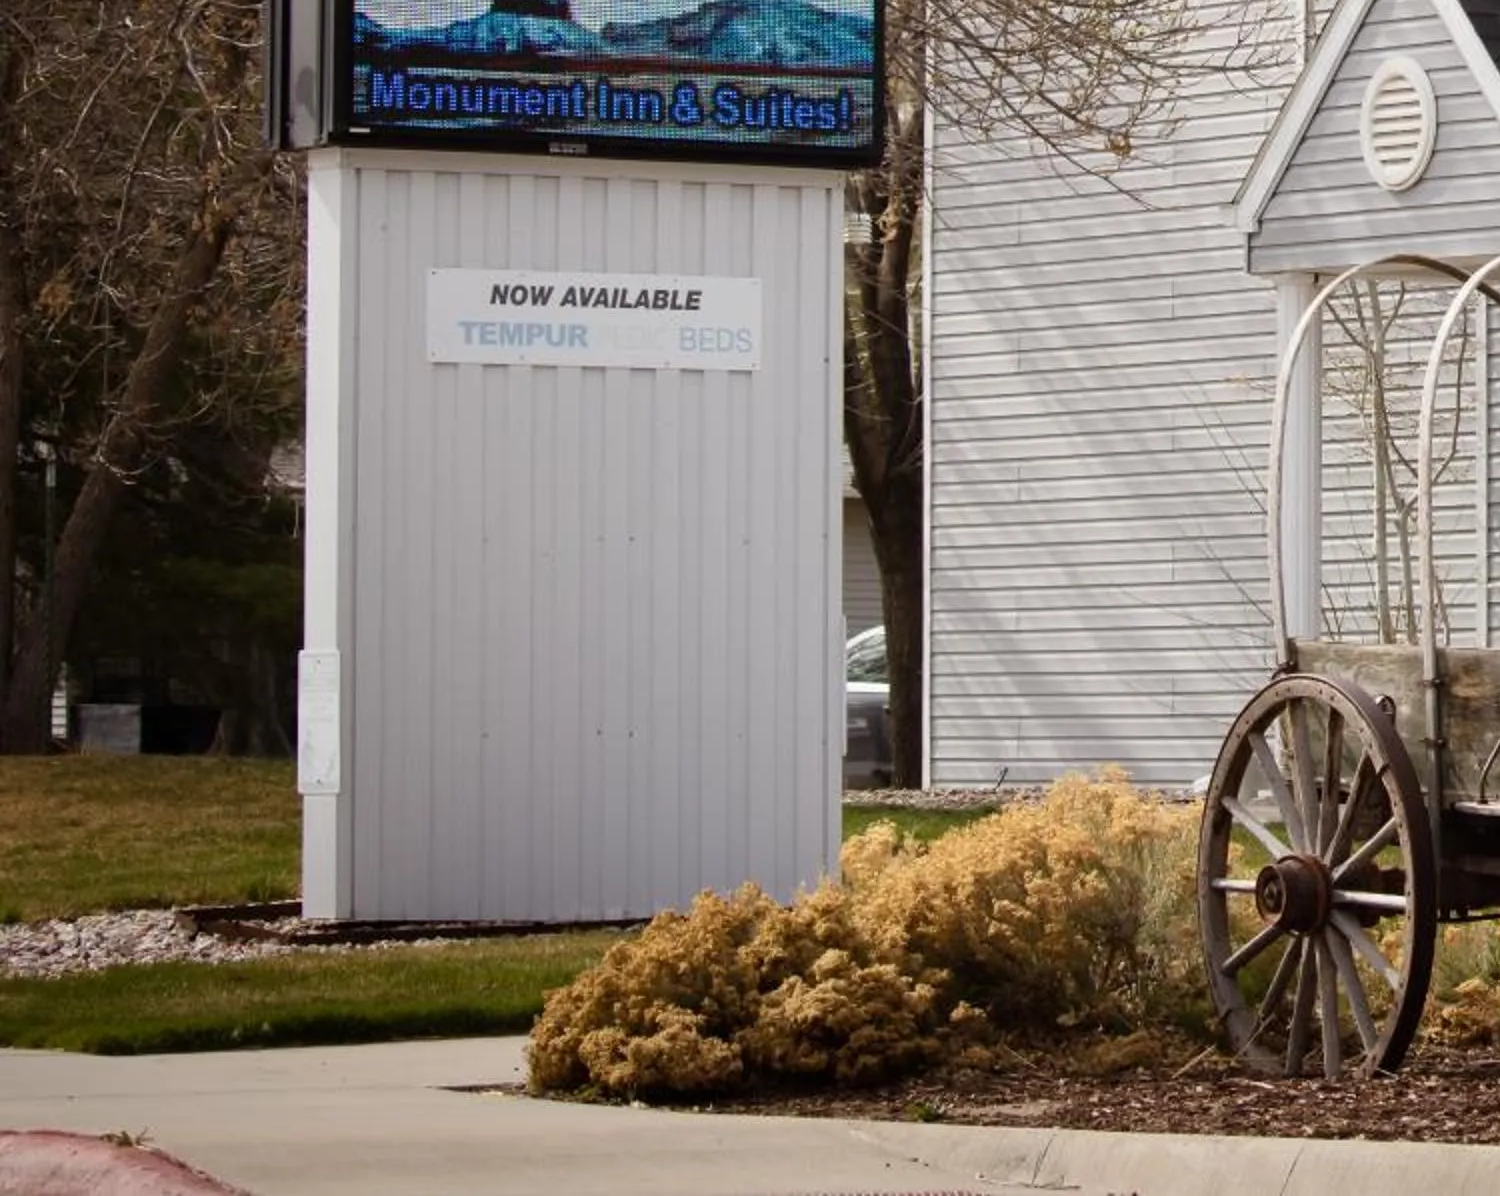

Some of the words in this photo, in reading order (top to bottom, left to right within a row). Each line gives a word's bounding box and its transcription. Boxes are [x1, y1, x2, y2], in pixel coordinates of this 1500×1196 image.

[372, 72, 585, 121] Monument
[598, 82, 662, 123] Inn
[671, 84, 702, 126] &
[714, 87, 851, 132] Suites!
[489, 284, 554, 307] NOW
[560, 287, 703, 311] AVAILABLE
[459, 321, 588, 348] TEMPUR
[679, 327, 754, 354] BEDS
